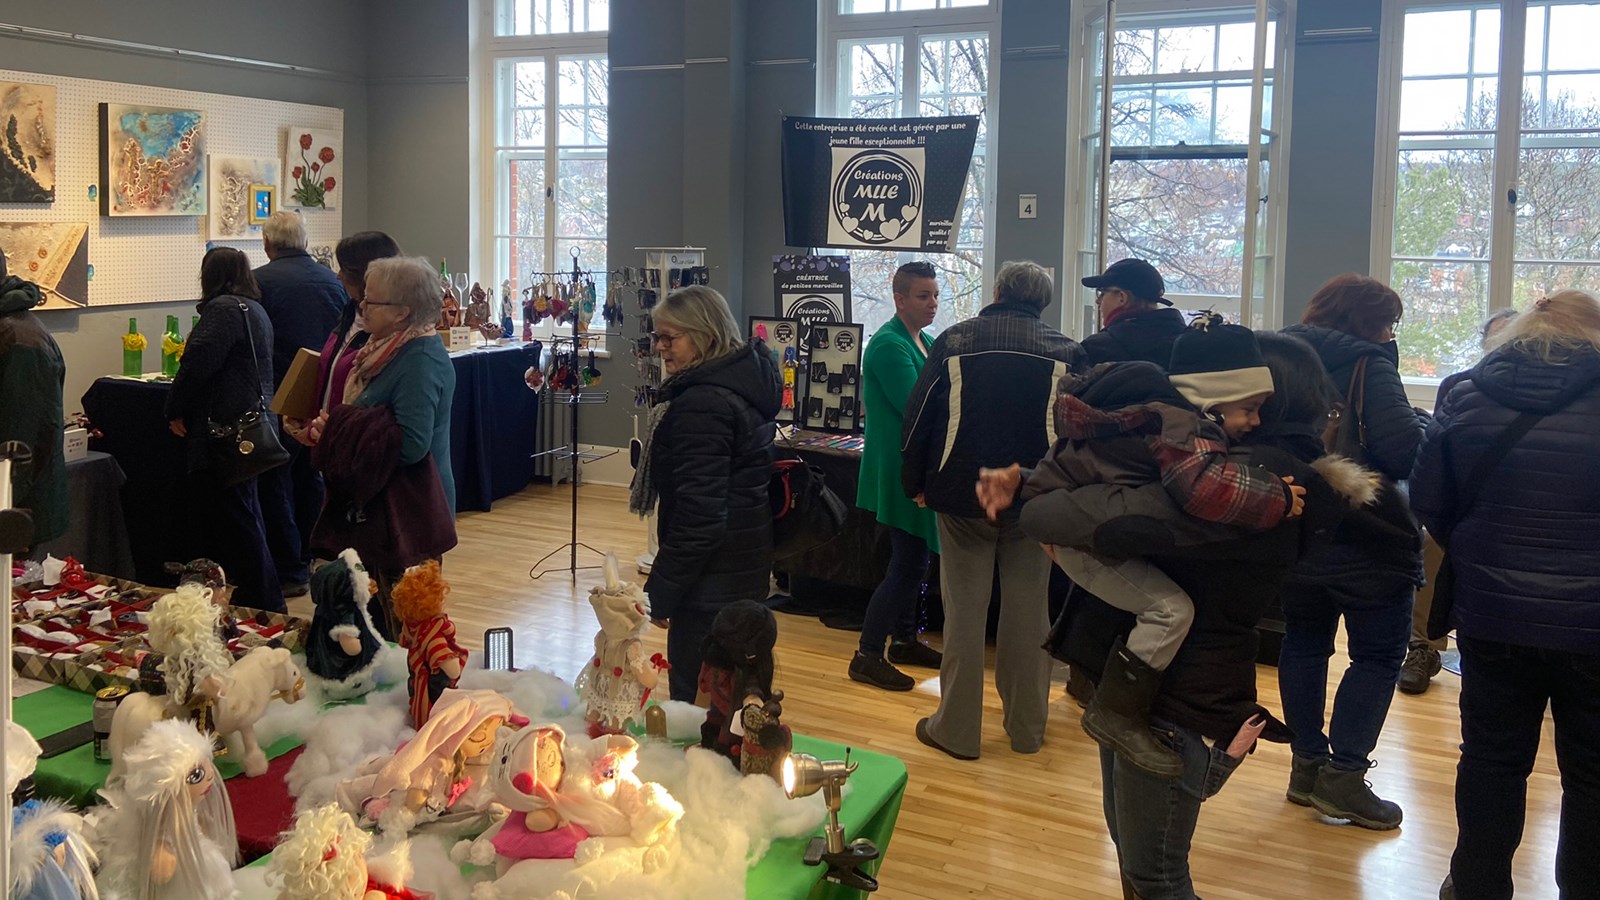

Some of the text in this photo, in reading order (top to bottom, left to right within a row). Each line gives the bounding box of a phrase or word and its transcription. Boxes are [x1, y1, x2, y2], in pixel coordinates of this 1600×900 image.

[795, 121, 813, 131] Cette
[813, 123, 848, 134] entreprise
[855, 123, 867, 132] été
[868, 124, 888, 132] créée
[889, 123, 898, 132] et
[898, 123, 911, 132] est
[912, 123, 934, 134] gérée
[935, 123, 950, 133] par
[828, 135, 849, 147] jeune
[849, 136, 864, 145] fille
[917, 135, 926, 145] !!!
[854, 169, 904, 182] Créations
[859, 202, 887, 222] M
[1024, 203, 1032, 215] 4
[796, 273, 829, 281] CRÉATRICE
[797, 307, 830, 315] Créations
